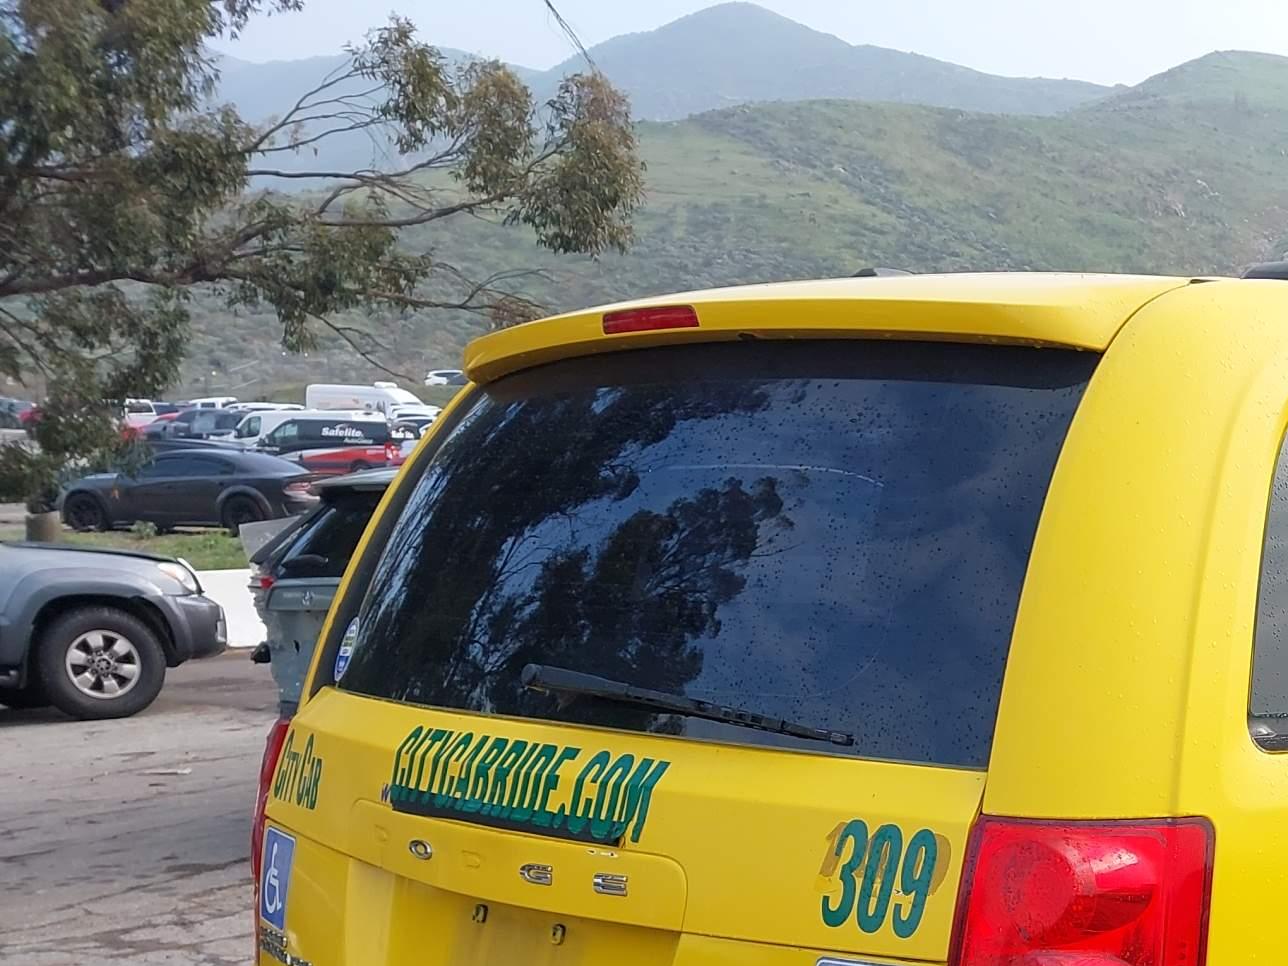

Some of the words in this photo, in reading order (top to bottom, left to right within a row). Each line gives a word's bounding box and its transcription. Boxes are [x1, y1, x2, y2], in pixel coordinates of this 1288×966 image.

[390, 725, 671, 843] CITYCABRIDE.COM
[375, 824, 628, 896] OGE
[821, 819, 938, 939] 309
